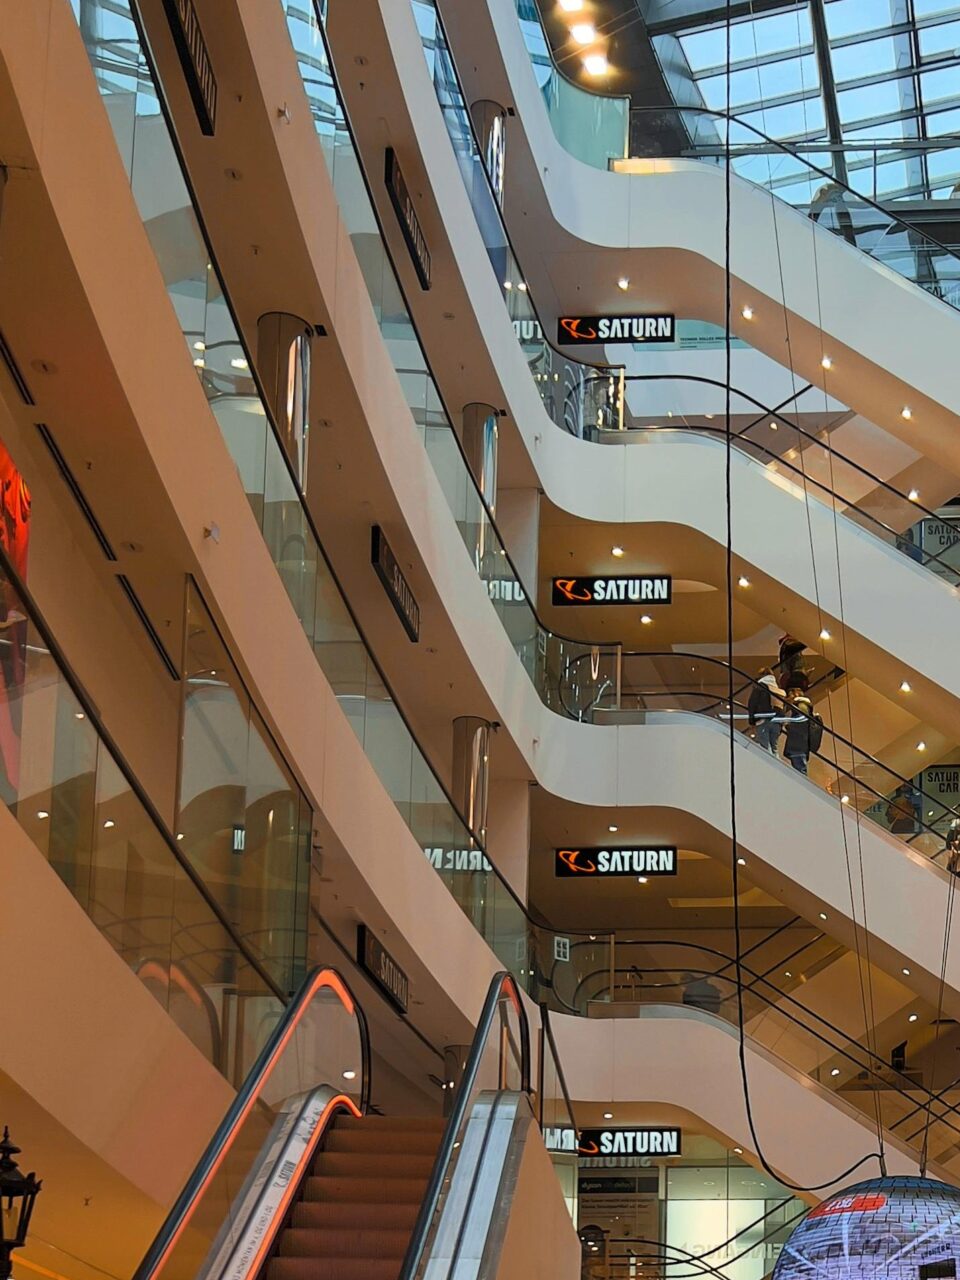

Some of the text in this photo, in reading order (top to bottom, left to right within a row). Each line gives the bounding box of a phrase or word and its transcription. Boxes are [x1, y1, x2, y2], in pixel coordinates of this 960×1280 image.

[598, 317, 672, 339] SATURN
[593, 579, 668, 601] SATURN
[597, 850, 674, 872] SATURN
[600, 1130, 678, 1154] SATURN
